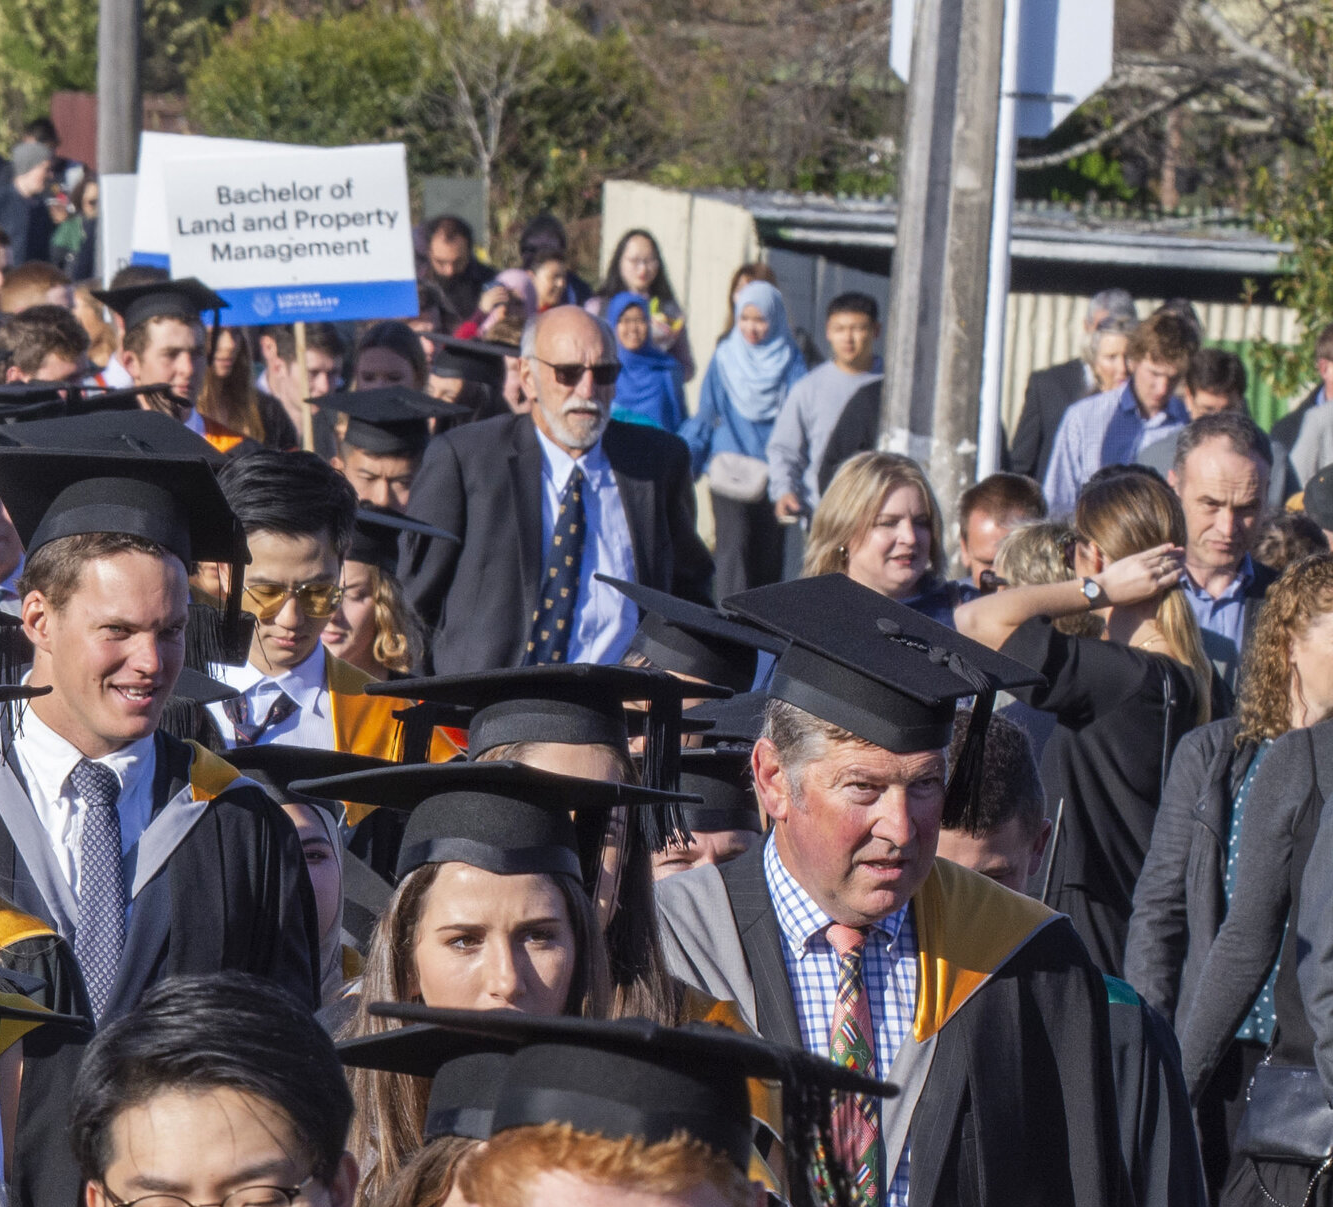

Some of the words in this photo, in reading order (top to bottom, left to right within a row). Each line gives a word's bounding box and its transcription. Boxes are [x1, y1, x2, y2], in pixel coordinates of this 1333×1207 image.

[217, 181, 323, 205] Bachelor
[330, 177, 354, 200] of
[177, 213, 236, 236] Land
[242, 209, 288, 232] and
[295, 206, 399, 231] Property
[211, 238, 370, 263] Management
